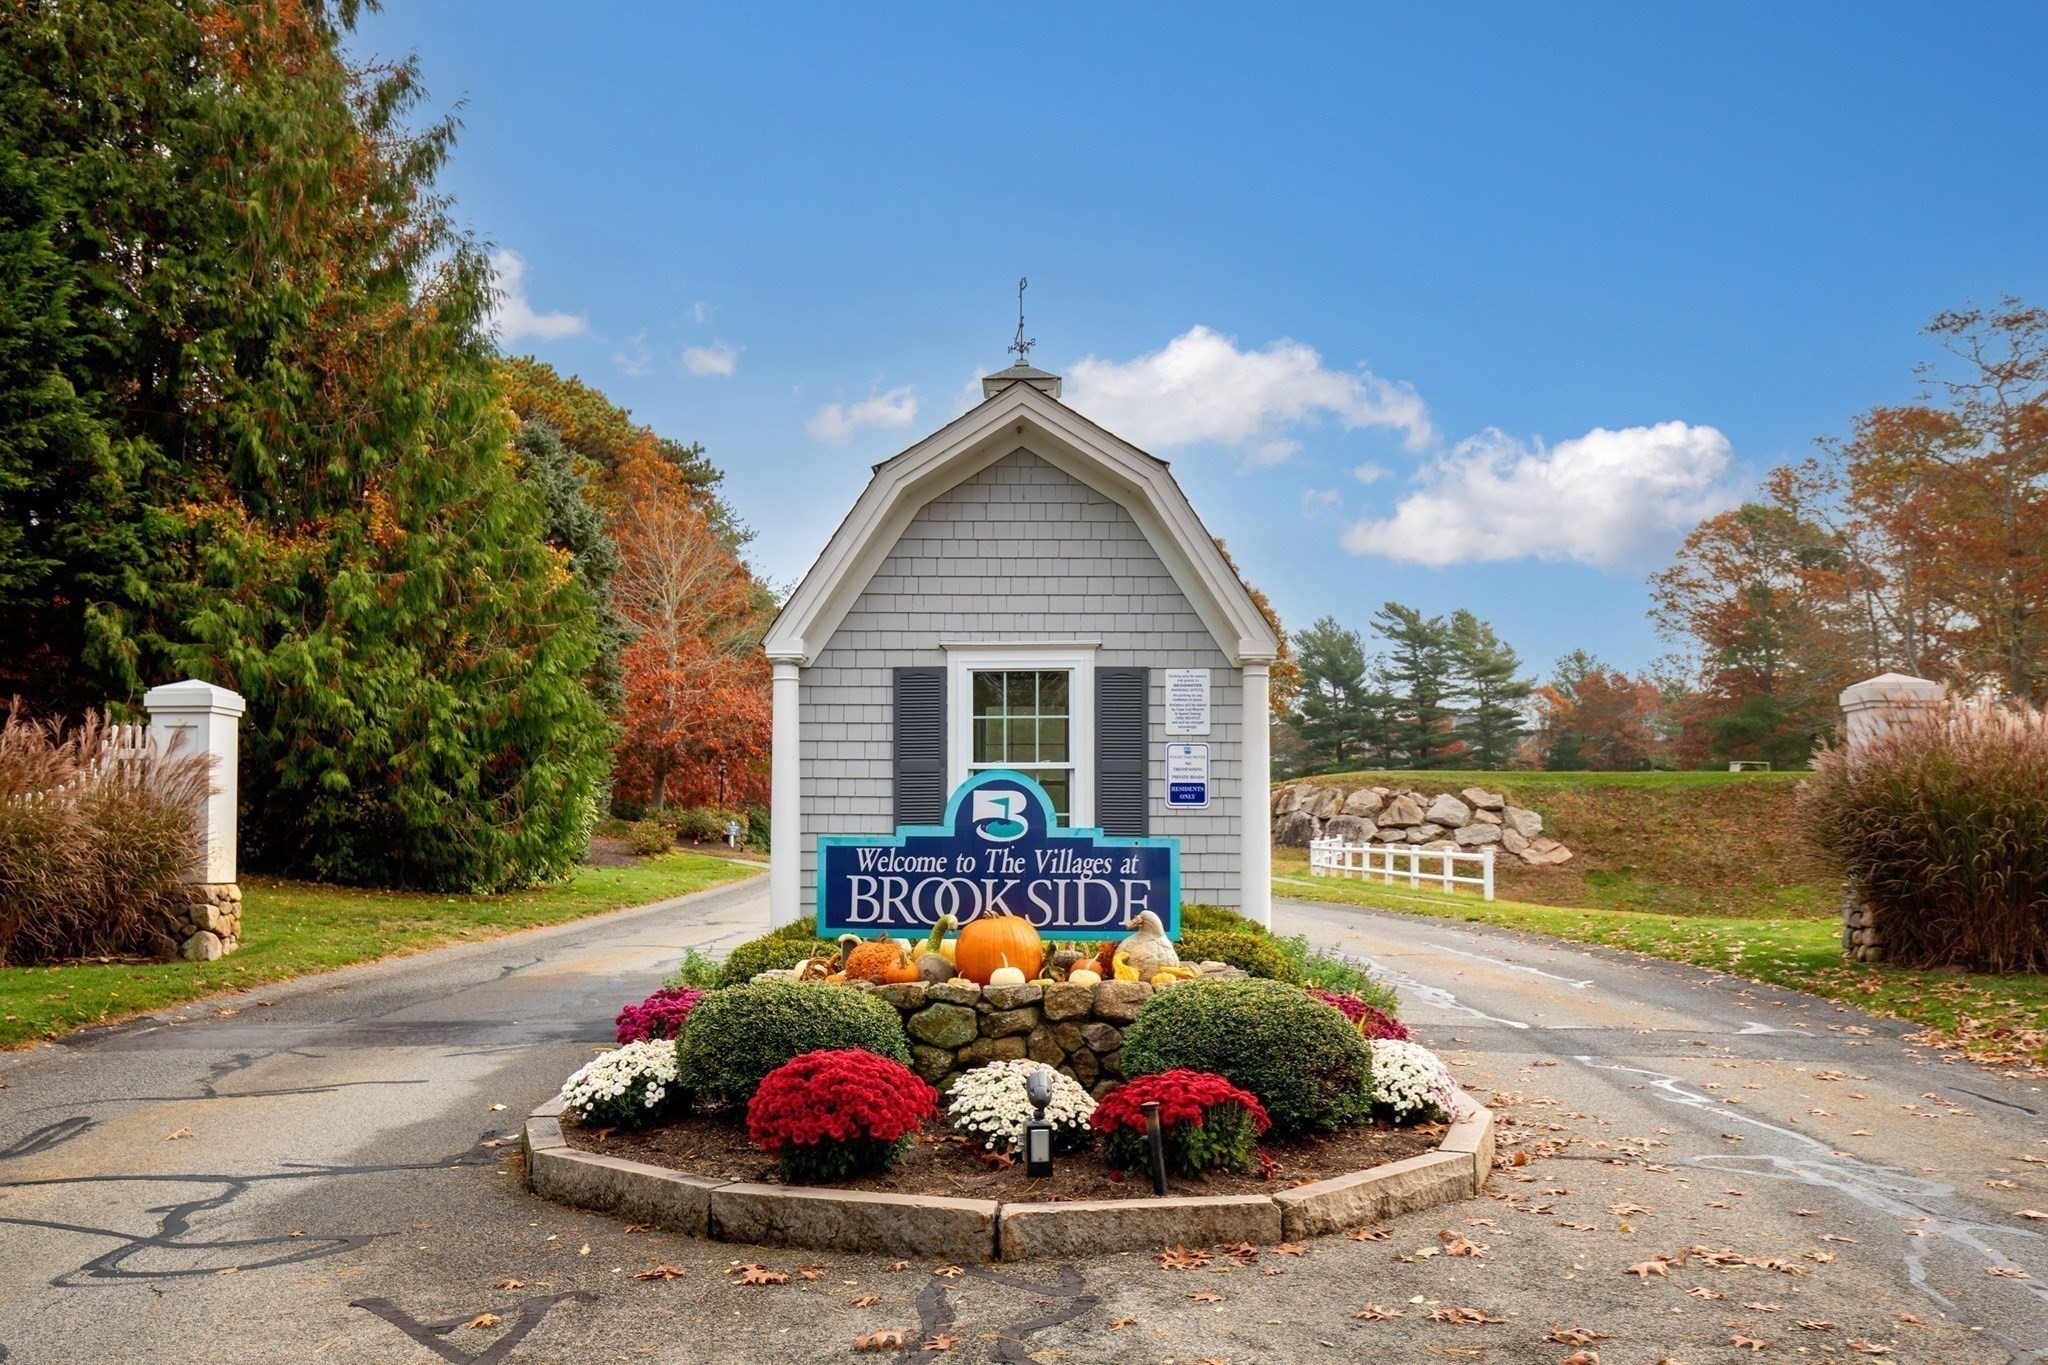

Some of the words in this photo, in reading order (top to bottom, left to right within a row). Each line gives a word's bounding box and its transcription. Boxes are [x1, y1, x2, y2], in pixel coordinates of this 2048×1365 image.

[856, 847, 947, 872] Welcome
[956, 853, 976, 873] to
[985, 848, 1026, 874] The
[1034, 848, 1112, 880] Villages
[1120, 854, 1140, 874] at
[846, 875, 1152, 927] BROOKSIDE
